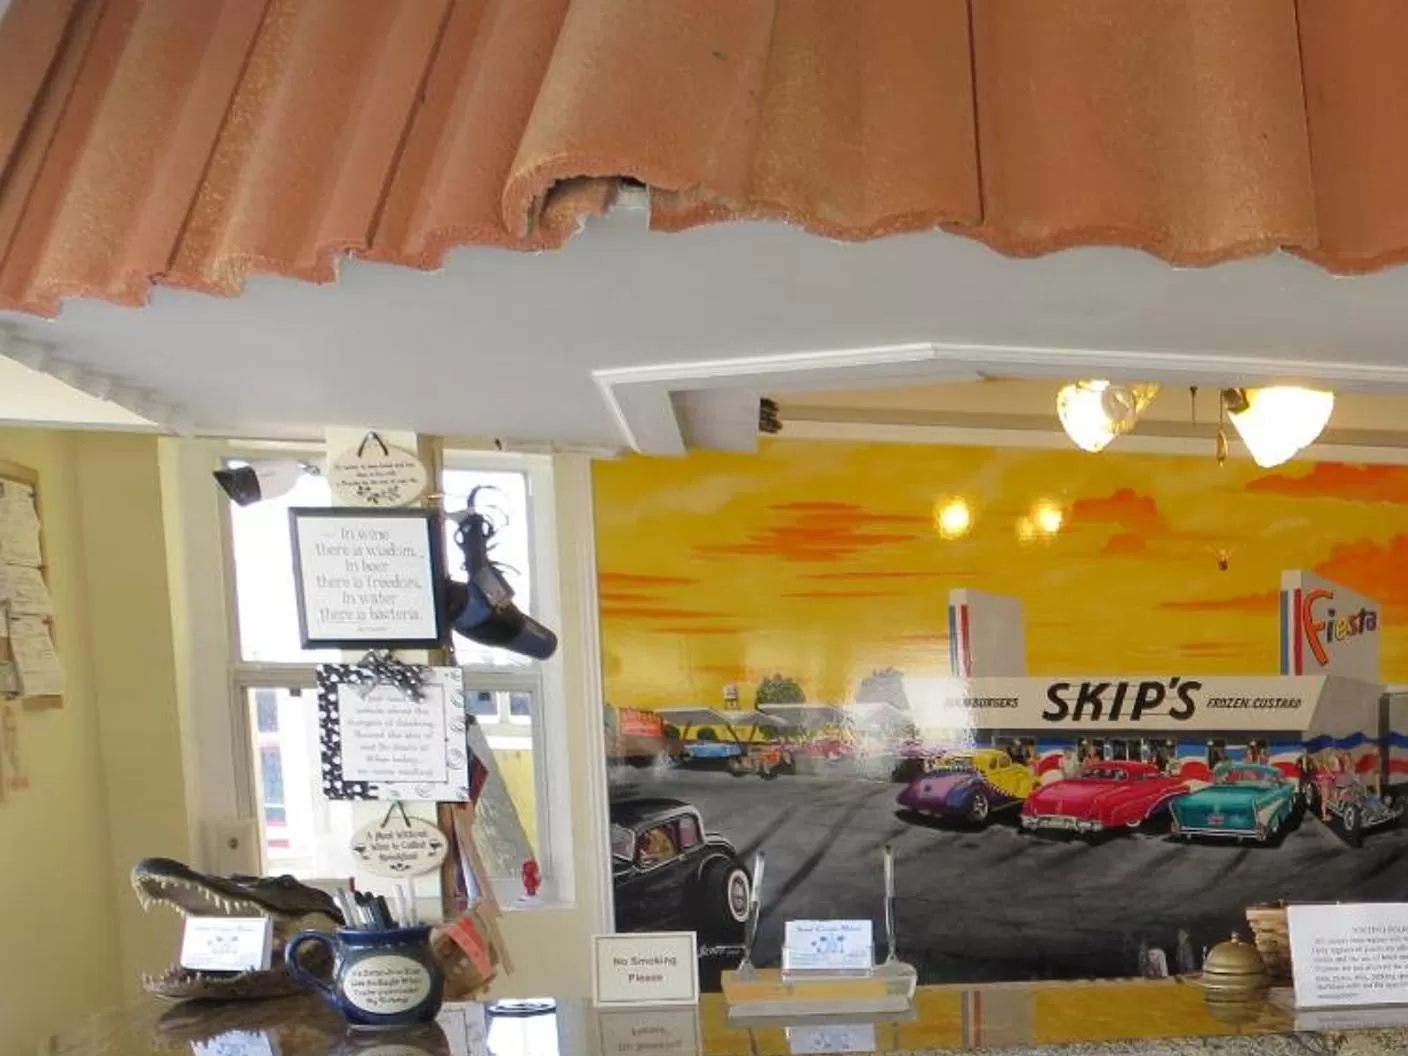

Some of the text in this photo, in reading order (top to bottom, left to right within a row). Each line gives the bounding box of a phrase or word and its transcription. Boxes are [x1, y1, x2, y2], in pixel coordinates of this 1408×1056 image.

[1302, 588, 1378, 667] Fiesta
[1042, 676, 1203, 723] SKIP'S
[1206, 698, 1302, 710] FROZEN CUSTARD
[613, 956, 678, 969] No Smoking
[628, 973, 664, 984] Please
